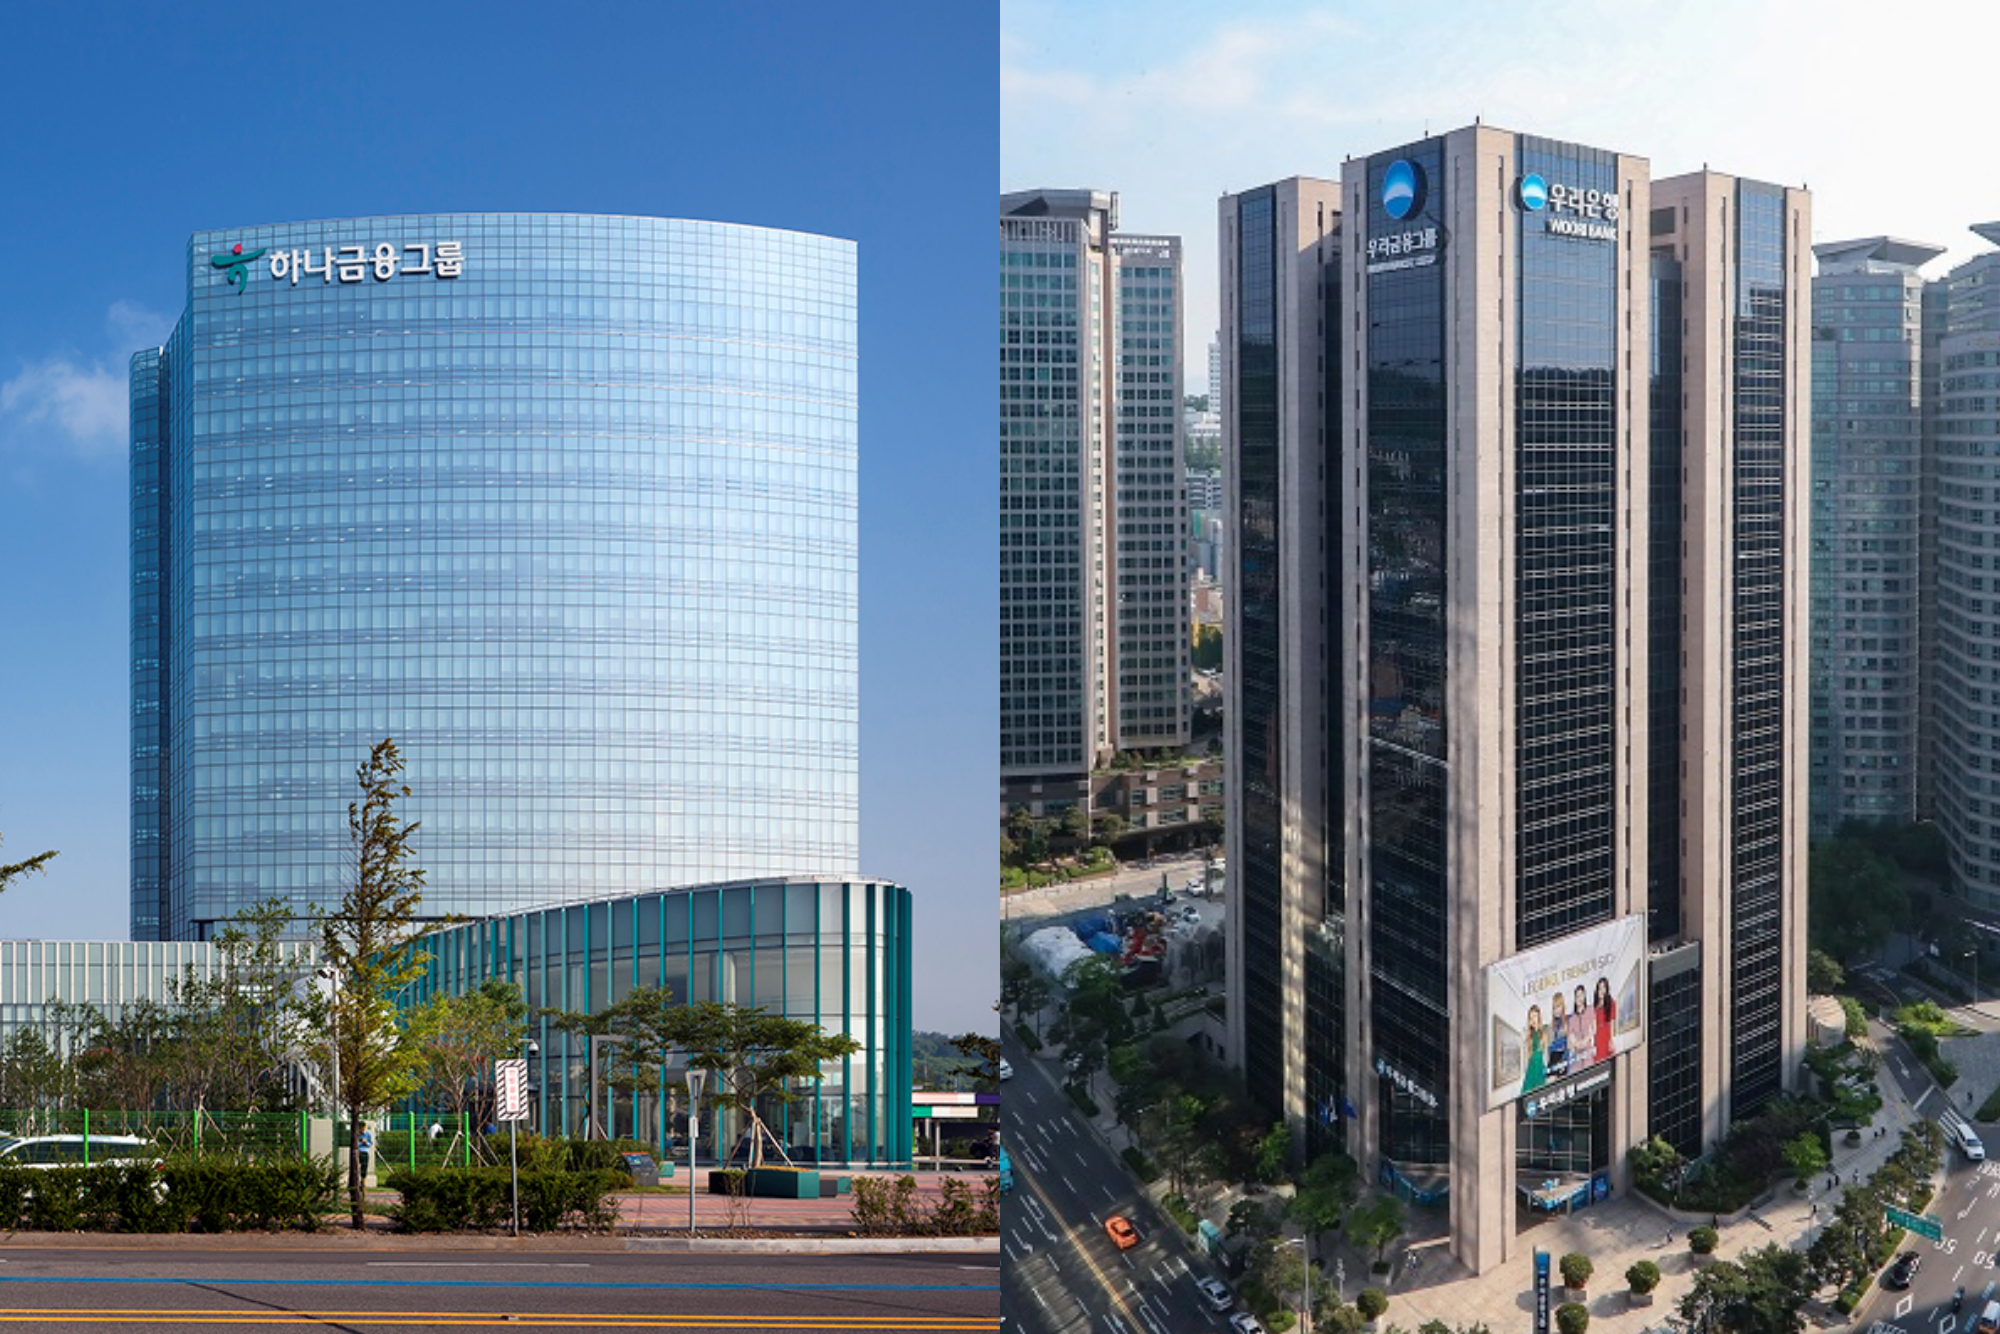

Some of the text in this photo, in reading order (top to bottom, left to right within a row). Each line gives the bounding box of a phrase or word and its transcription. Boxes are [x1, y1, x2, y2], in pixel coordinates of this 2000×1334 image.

[1549, 183, 1618, 220] 우리은행
[1367, 228, 1438, 258] 우리금융그룹
[270, 241, 465, 283] 하나금융그룹
